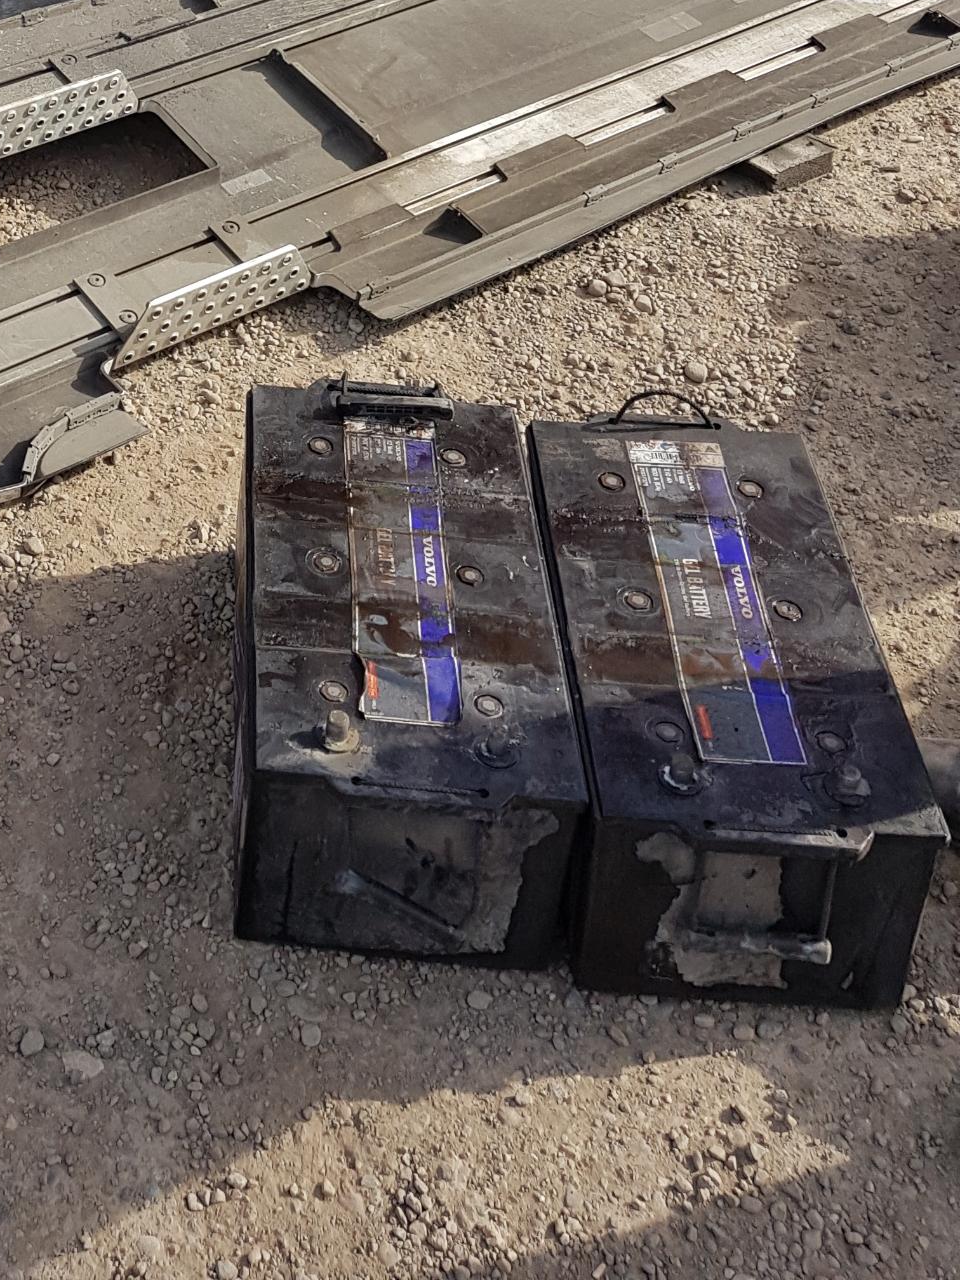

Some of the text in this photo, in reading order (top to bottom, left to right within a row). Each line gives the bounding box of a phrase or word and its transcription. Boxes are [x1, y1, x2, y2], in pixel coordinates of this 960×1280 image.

[422, 534, 438, 588] VOLVO
[686, 576, 713, 619] BATTERY
[731, 564, 753, 619] VOLVO
